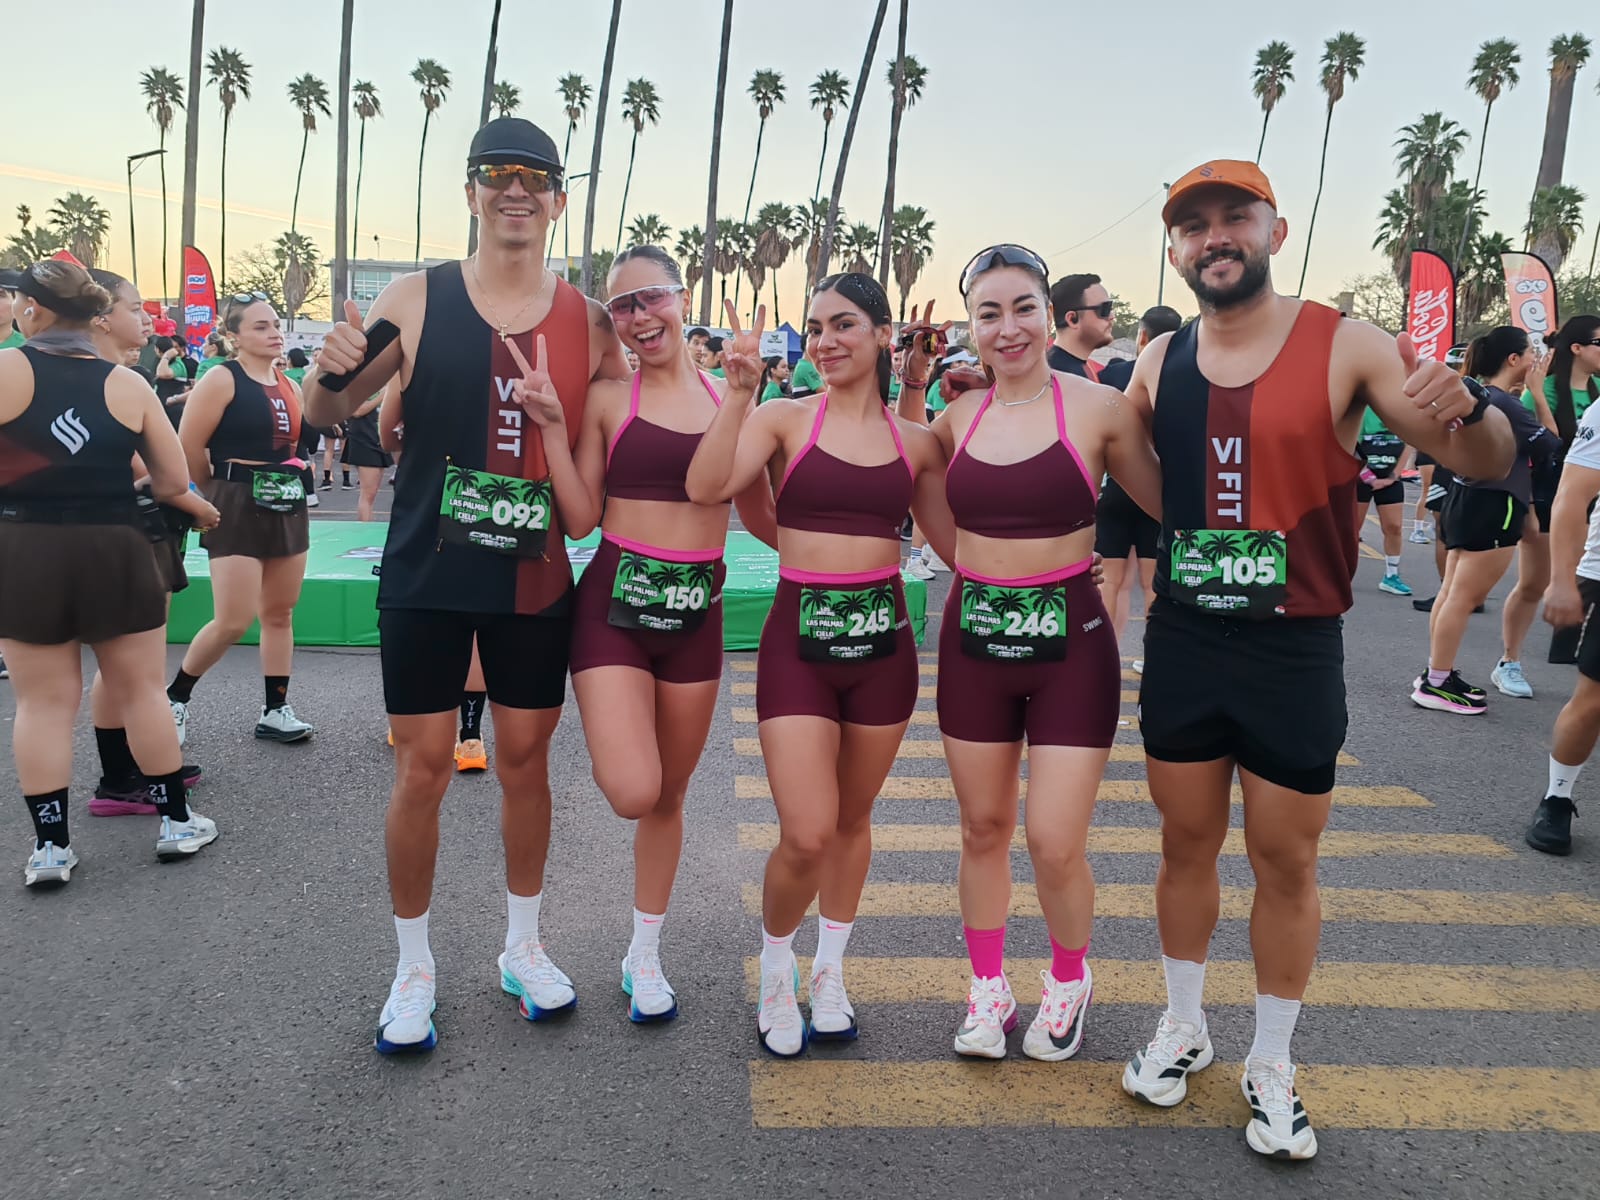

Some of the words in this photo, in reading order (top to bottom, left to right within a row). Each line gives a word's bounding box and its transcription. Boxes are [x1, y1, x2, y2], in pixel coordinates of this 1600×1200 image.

[276, 411, 290, 433] FIT
[496, 410, 521, 458] FIT
[1211, 437, 1242, 464] VI
[1217, 472, 1242, 523] FIT
[449, 498, 463, 507] LAS
[463, 501, 489, 512] PALMAS
[457, 511, 477, 521] CIELO
[492, 499, 546, 530] 092
[1187, 563, 1212, 572] PALMAS
[1217, 556, 1277, 585] 105
[1184, 576, 1202, 584] CIELO
[621, 583, 633, 592] LAS
[633, 585, 658, 597] PALMAS
[628, 596, 647, 605] CIELO
[664, 586, 705, 610] 150
[819, 620, 844, 628] PALMAS
[848, 607, 890, 637] 245
[966, 613, 978, 622] LAS
[977, 615, 1001, 625] PALMAS
[1004, 611, 1060, 637] 246
[974, 625, 992, 634] CIELO
[148, 784, 167, 796] 21
[36, 800, 61, 817] 21
[40, 813, 62, 824] KM
